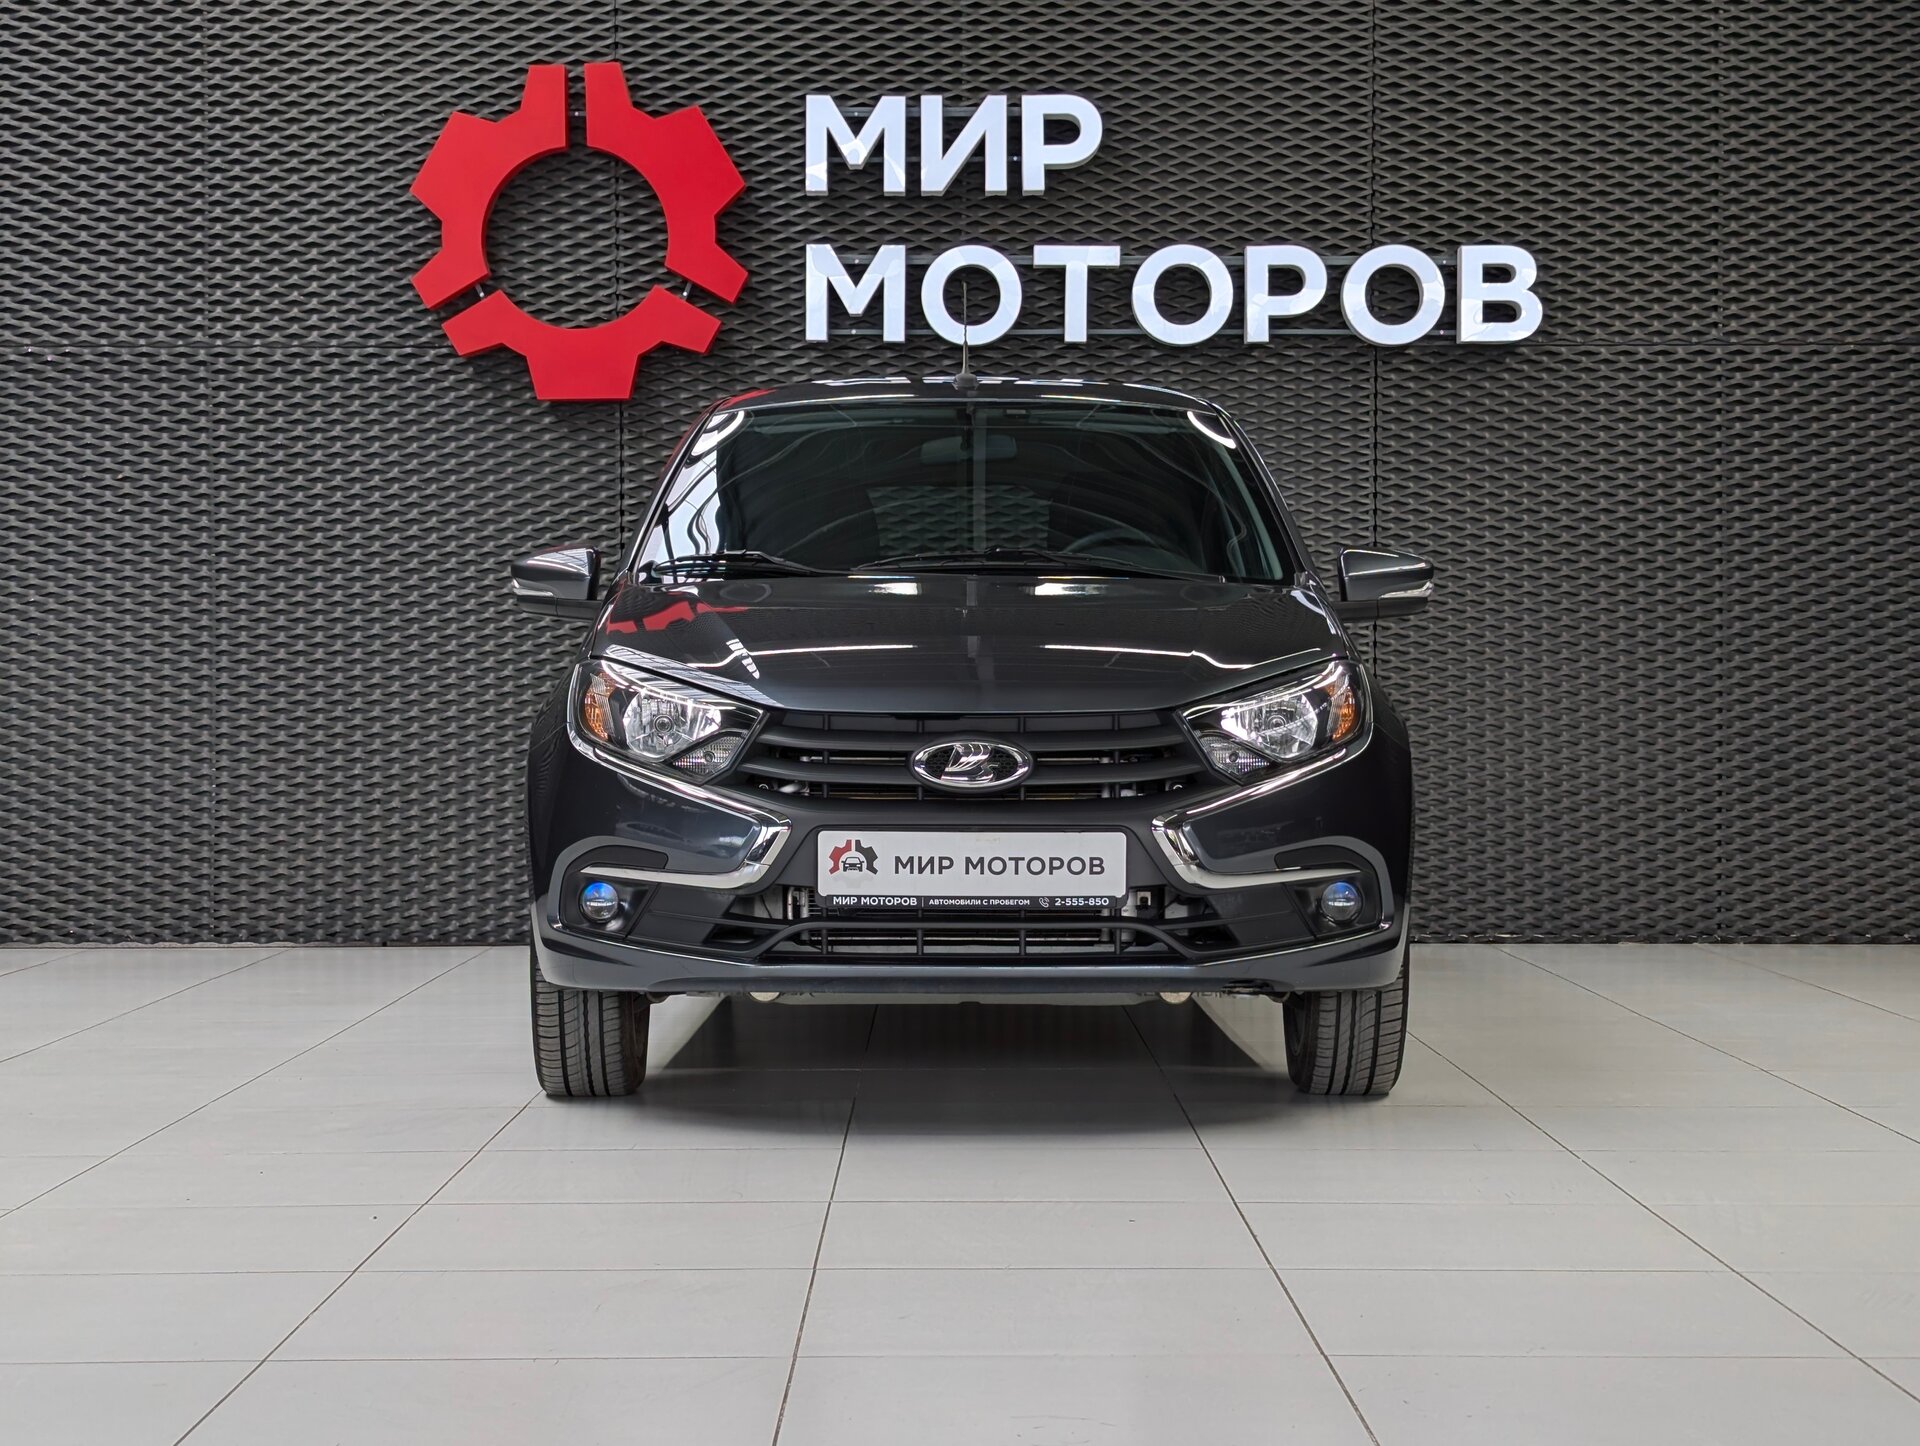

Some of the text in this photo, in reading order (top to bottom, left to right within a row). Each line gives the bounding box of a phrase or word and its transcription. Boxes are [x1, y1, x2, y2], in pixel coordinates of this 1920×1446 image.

[805, 94, 1103, 197] МИР
[804, 243, 1544, 346] МОТОРОВ
[894, 856, 1105, 875] МИР МОТОРОВ
[832, 896, 918, 906] МИР МОТОРОВ
[1054, 897, 1109, 906] 2-555-850
